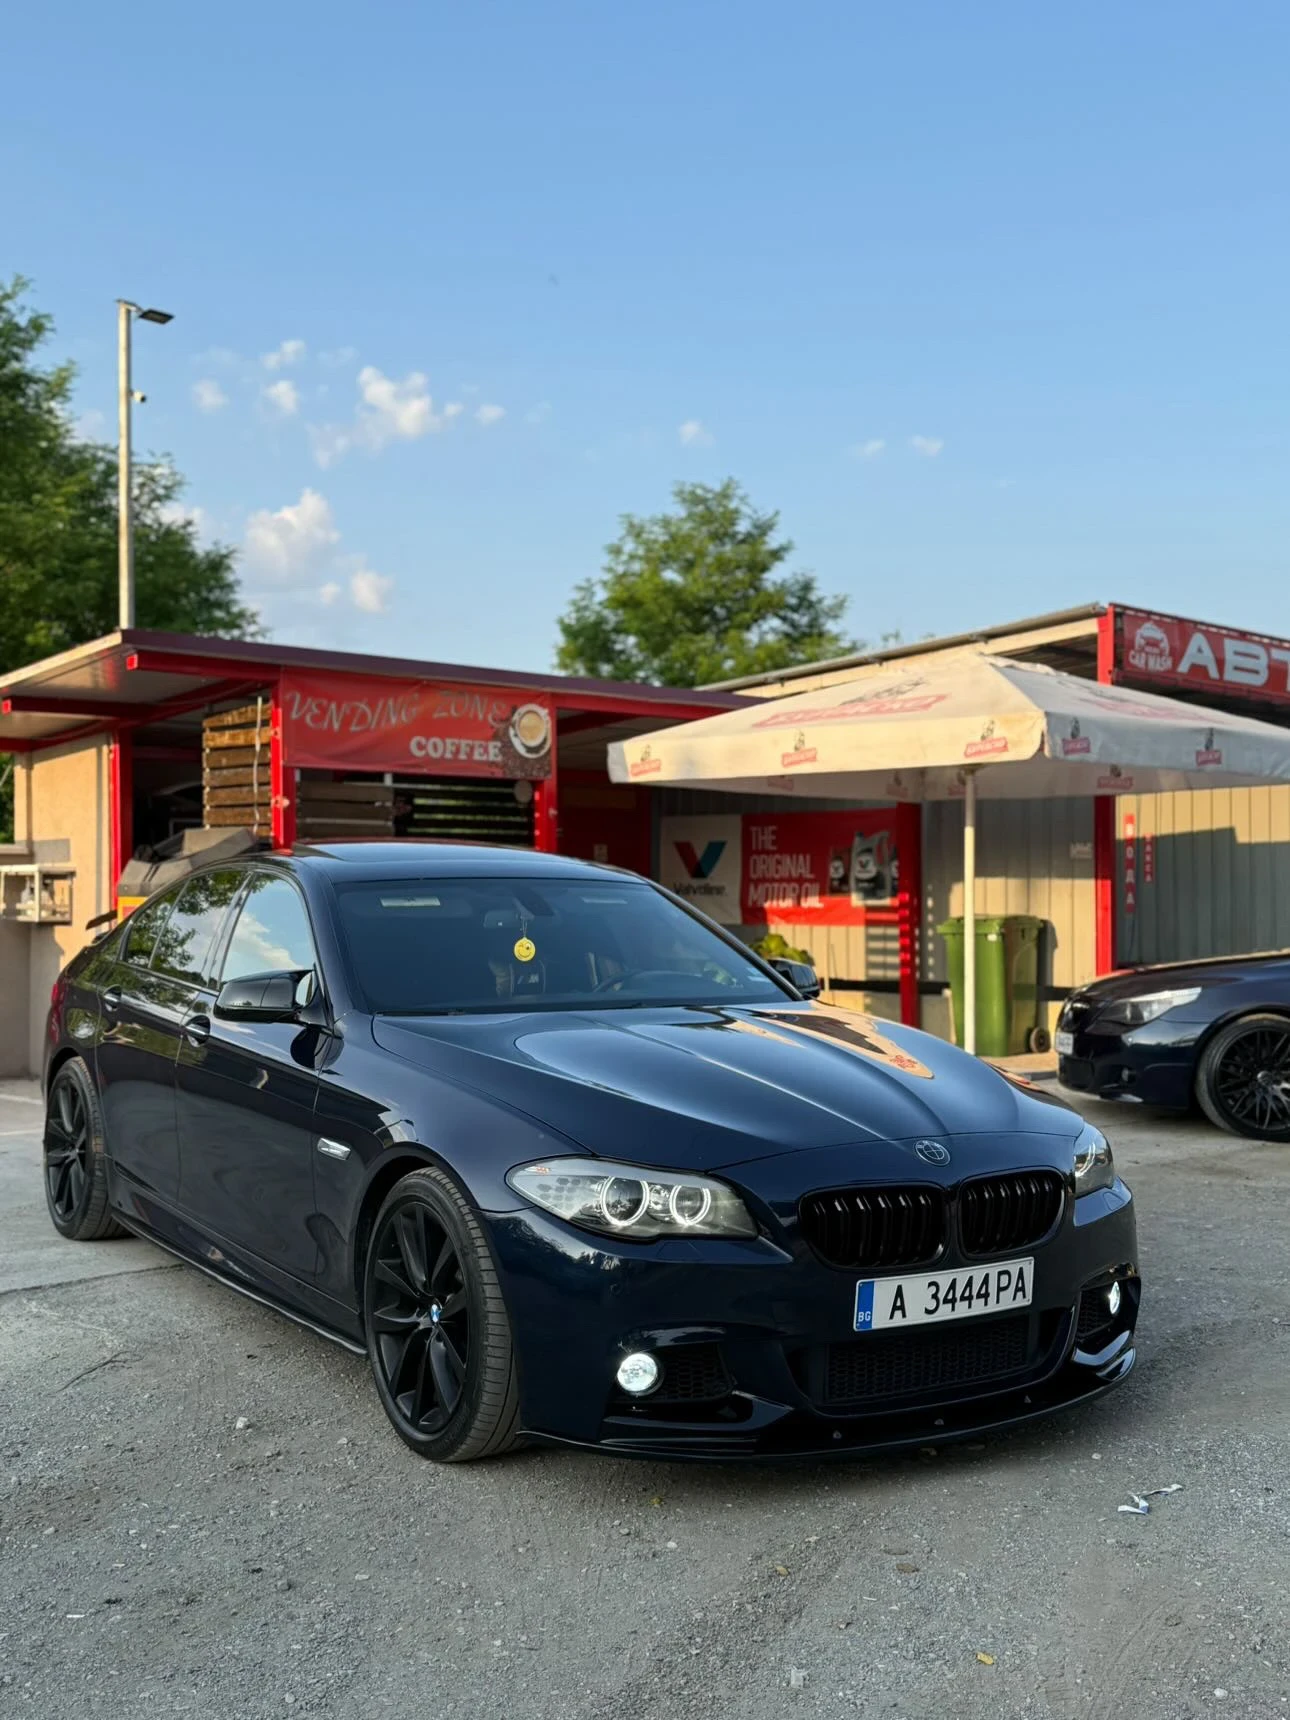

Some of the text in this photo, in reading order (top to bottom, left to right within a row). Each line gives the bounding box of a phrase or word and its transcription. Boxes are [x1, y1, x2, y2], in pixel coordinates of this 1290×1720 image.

[1128, 649, 1173, 672] CAR WASH
[285, 690, 507, 732] VENDING ZONE
[410, 736, 503, 761] COFFEE
[750, 826, 777, 850] THE
[750, 854, 814, 879] ORIGINAL
[749, 882, 824, 908] MOTOR OIL
[889, 1284, 907, 1320] A
[858, 1311, 871, 1322] BG
